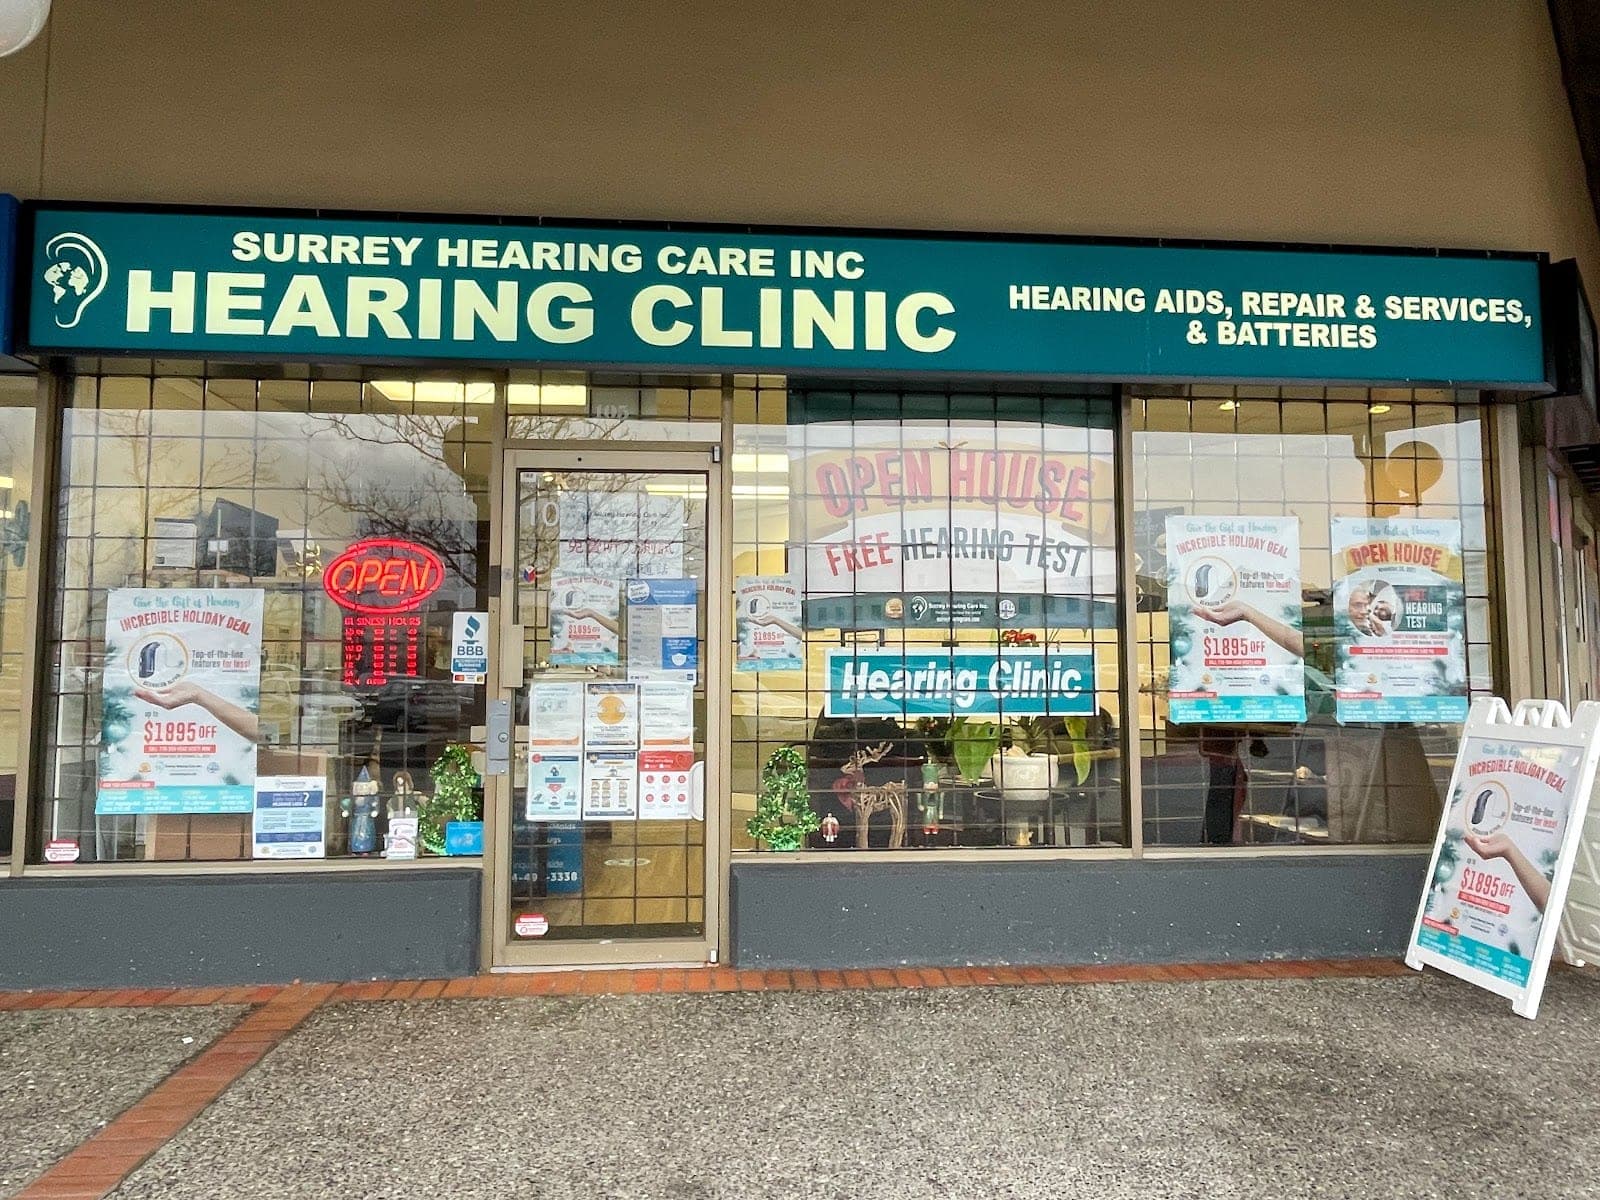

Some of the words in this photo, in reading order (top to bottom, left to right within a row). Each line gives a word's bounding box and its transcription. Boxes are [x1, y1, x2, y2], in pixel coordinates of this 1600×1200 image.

[232, 231, 422, 266] SURREY
[437, 239, 642, 273] HEARING
[657, 246, 775, 277] CARE
[790, 250, 865, 280] INC
[127, 269, 594, 344] HEARING
[630, 285, 956, 353] CLINIC
[1009, 285, 1146, 313] HEARING
[1155, 289, 1233, 320] AIDS,
[1241, 292, 1346, 318] REPAIR
[1355, 294, 1377, 319] &
[1385, 296, 1532, 329] SERVICES,
[1187, 320, 1208, 345] &
[1217, 321, 1377, 349] BATTERIES
[815, 449, 933, 518] OPEN
[950, 449, 1096, 522] HOUSE
[825, 531, 894, 577] FREE
[901, 527, 1015, 562] HEARING
[1024, 533, 1087, 577] TEST
[1176, 535, 1226, 556] INCREDIBLE
[1228, 535, 1265, 550] HOLIDAY
[1266, 542, 1289, 559] DEAL
[1350, 543, 1388, 568] OPEN
[1394, 543, 1441, 568] HOUSE
[331, 559, 432, 595] OPEN
[119, 610, 180, 632] INCREDIBLE
[182, 609, 225, 628] HOLIDAY
[226, 616, 252, 636] DEAL
[1405, 602, 1443, 616] HEARING
[1406, 615, 1428, 629] TEST
[457, 645, 484, 656] BBB
[1203, 636, 1249, 657] $1895
[1251, 641, 1265, 653] OFF
[192, 659, 220, 668] features
[841, 661, 978, 708] Hearing
[989, 659, 1083, 700] Clinic
[144, 719, 197, 743] $1895
[199, 725, 217, 739] OFF
[1469, 759, 1513, 777] INCREDIBLE
[1514, 759, 1549, 780] HOLIDAY
[1545, 771, 1567, 793] DEAL
[1461, 867, 1502, 898] $1895
[1500, 882, 1516, 898] OFF
